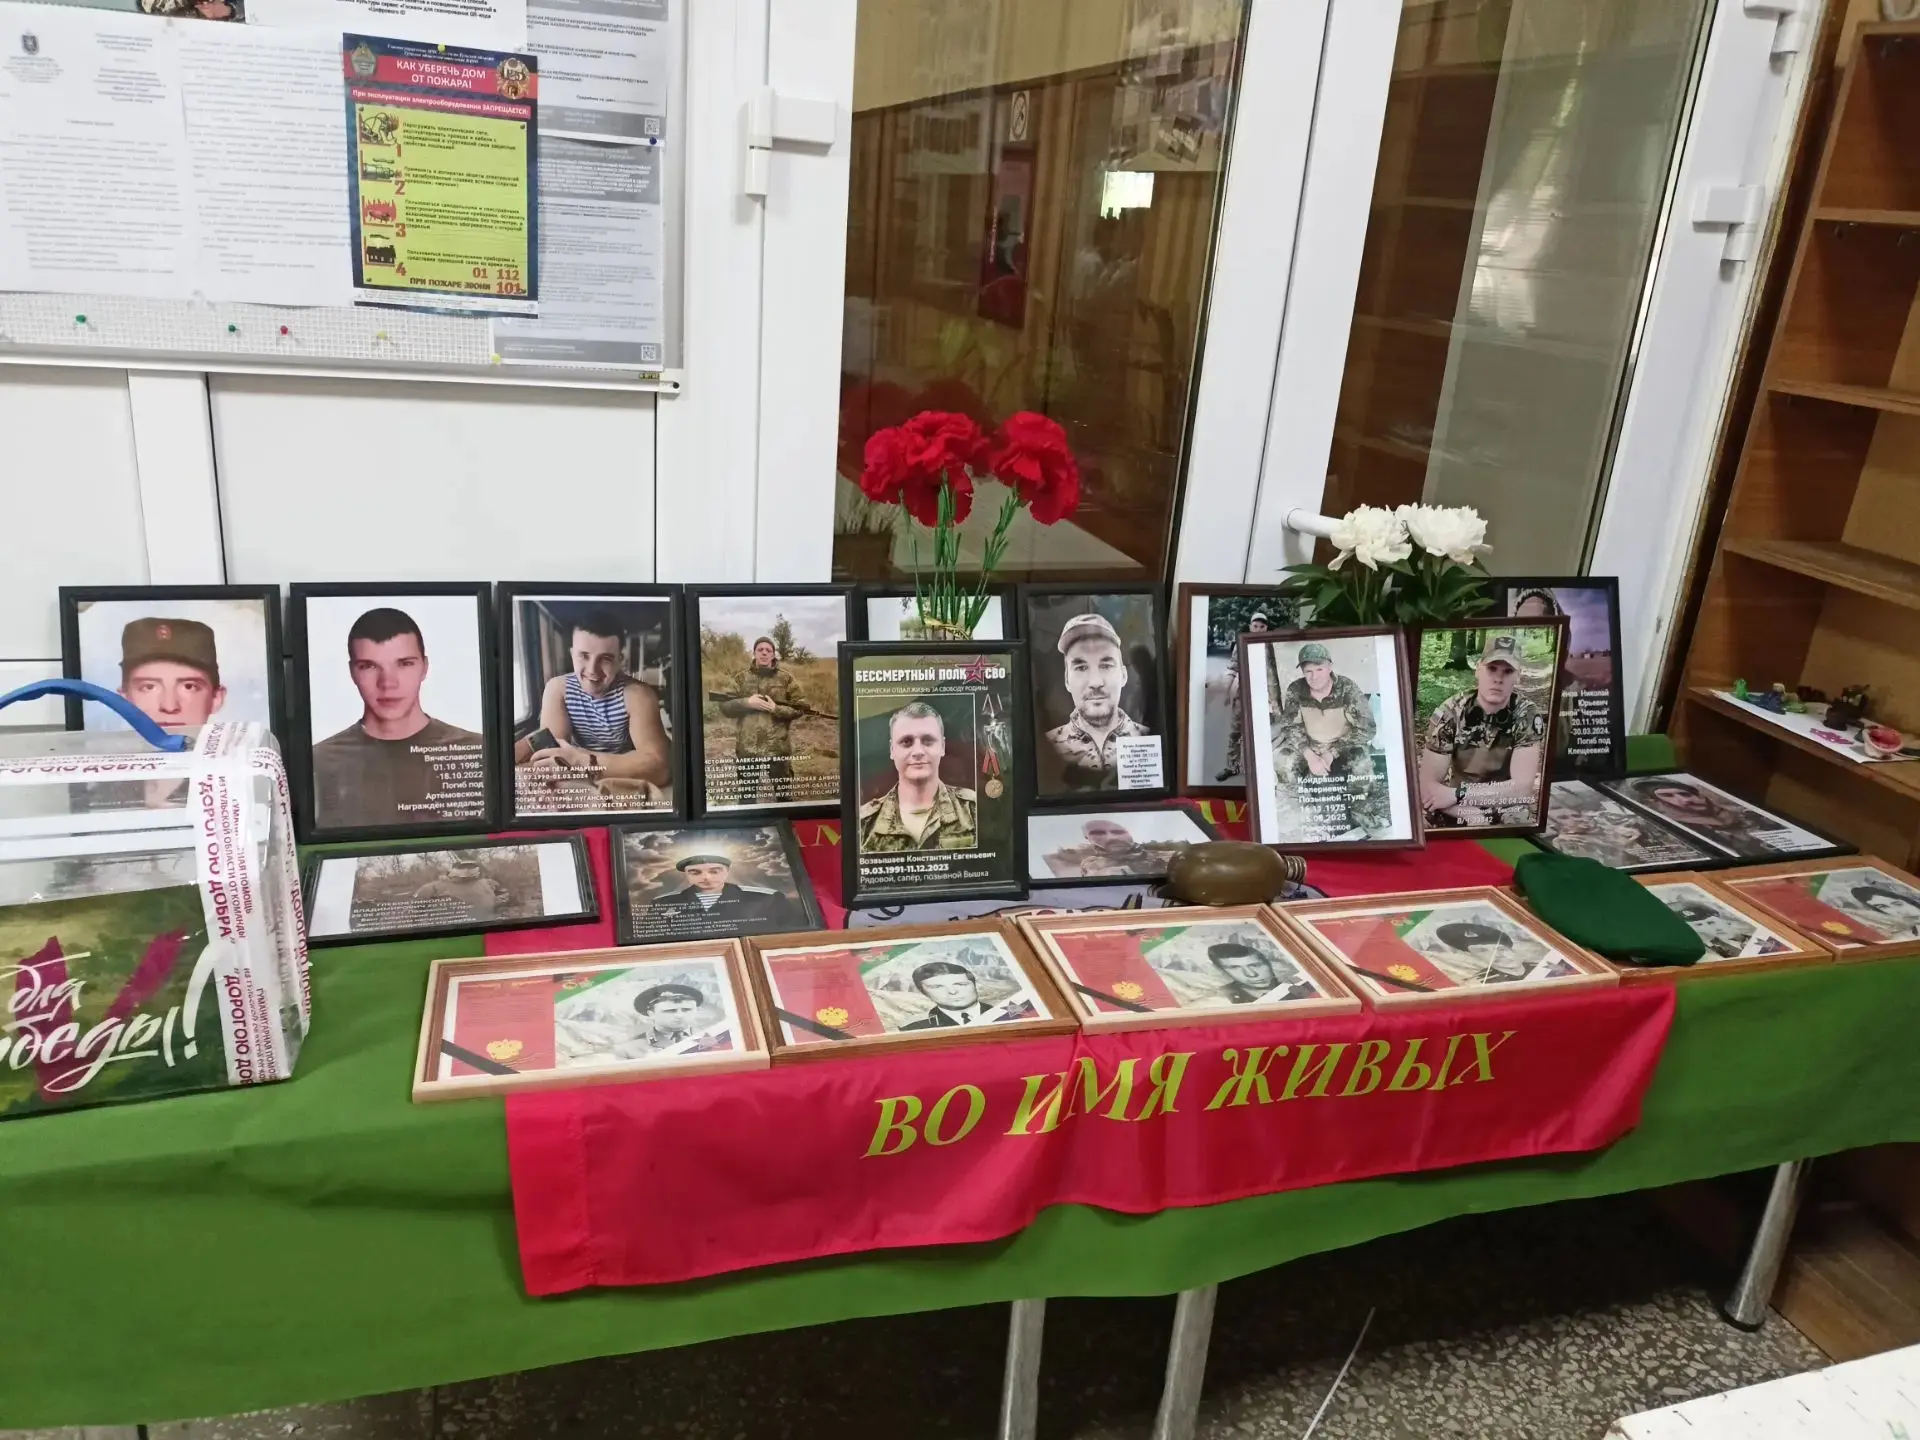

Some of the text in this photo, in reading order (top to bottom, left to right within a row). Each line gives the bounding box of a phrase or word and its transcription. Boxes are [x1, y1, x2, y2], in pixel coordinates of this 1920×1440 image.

[397, 60, 486, 79] КАК УБЕРЕЧЬ ДОМ
[412, 73, 472, 89] ОТ ПОЖАРА!
[352, 89, 366, 98] При
[368, 91, 411, 103] эксплуатации
[395, 182, 405, 195] 2
[396, 223, 406, 237] 3
[396, 262, 407, 276] 4
[473, 267, 519, 280] 01 112
[410, 277, 521, 295] ПРИ ПОЖАРЕ ЗВОНИ 101
[855, 667, 1006, 682] БЕССМЕРТНЫЙ ПОЛК СВО
[939, 685, 964, 693] СВОБОДУ
[1580, 689, 1609, 697] Николай
[1577, 737, 1597, 745] Погиб
[410, 745, 448, 754] Миронов
[1568, 745, 1610, 755] Клещеевкой
[424, 754, 483, 762] Вячеславович
[433, 763, 456, 771] 01.10
[436, 771, 483, 780] -18.10.2022
[1297, 773, 1385, 784] Кондрашов Дмитрий
[442, 781, 467, 789] Погиб
[1298, 786, 1347, 794] Валериевич
[1299, 792, 1368, 803] Позывной "Тула"
[446, 800, 484, 808] медалью
[220, 788, 232, 834] ТУЛЬСКОЙ
[454, 808, 485, 817] Отвагу"
[224, 836, 237, 880] ОБЛАСТИ
[860, 852, 996, 865] Возвышаев Константин Евгеньевич
[860, 864, 949, 875] 19.03.1991-11.12.2023
[860, 875, 896, 884] Рядовой,
[924, 872, 961, 880] позывной
[228, 881, 238, 892] ОТ
[240, 873, 253, 914] ПОМОЩЬ
[233, 893, 246, 938] КОМАНДЫ
[224, 968, 249, 1055] "ДОРОГОЮ
[860, 1031, 1518, 1159] ВО ИМЯ ЖИВЫХ
